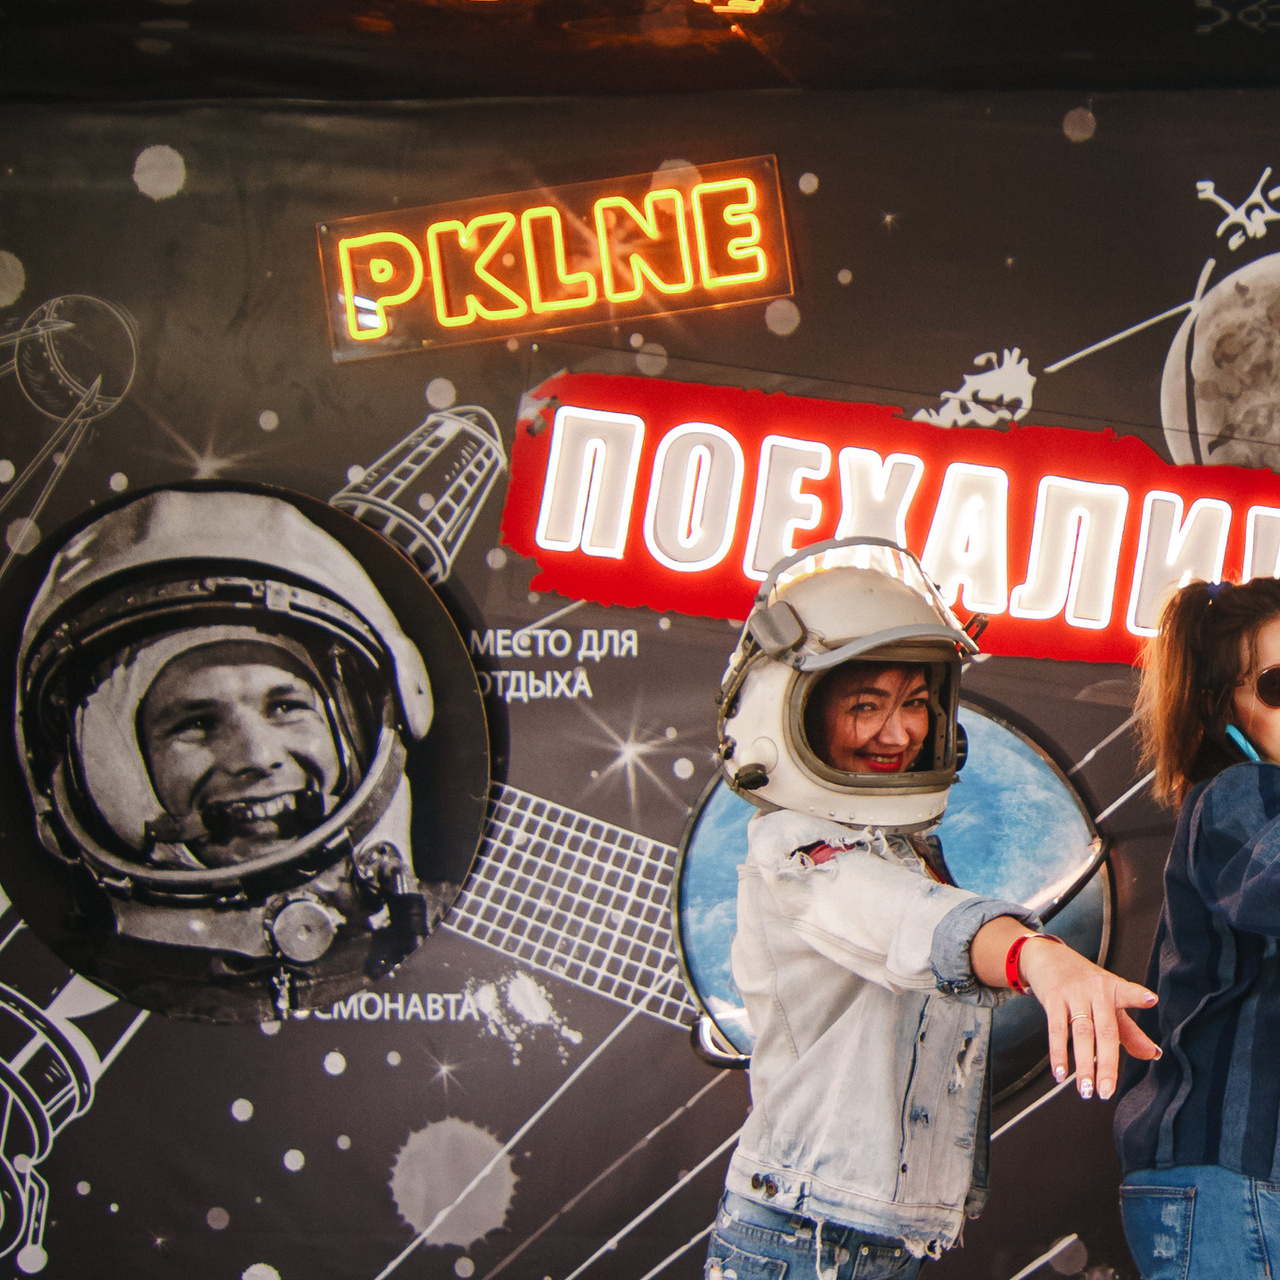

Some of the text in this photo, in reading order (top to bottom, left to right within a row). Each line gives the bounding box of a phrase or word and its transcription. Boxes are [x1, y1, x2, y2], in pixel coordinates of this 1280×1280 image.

[338, 178, 767, 341] PKLNE
[470, 628, 638, 662] МЕСТО ДЛЯ
